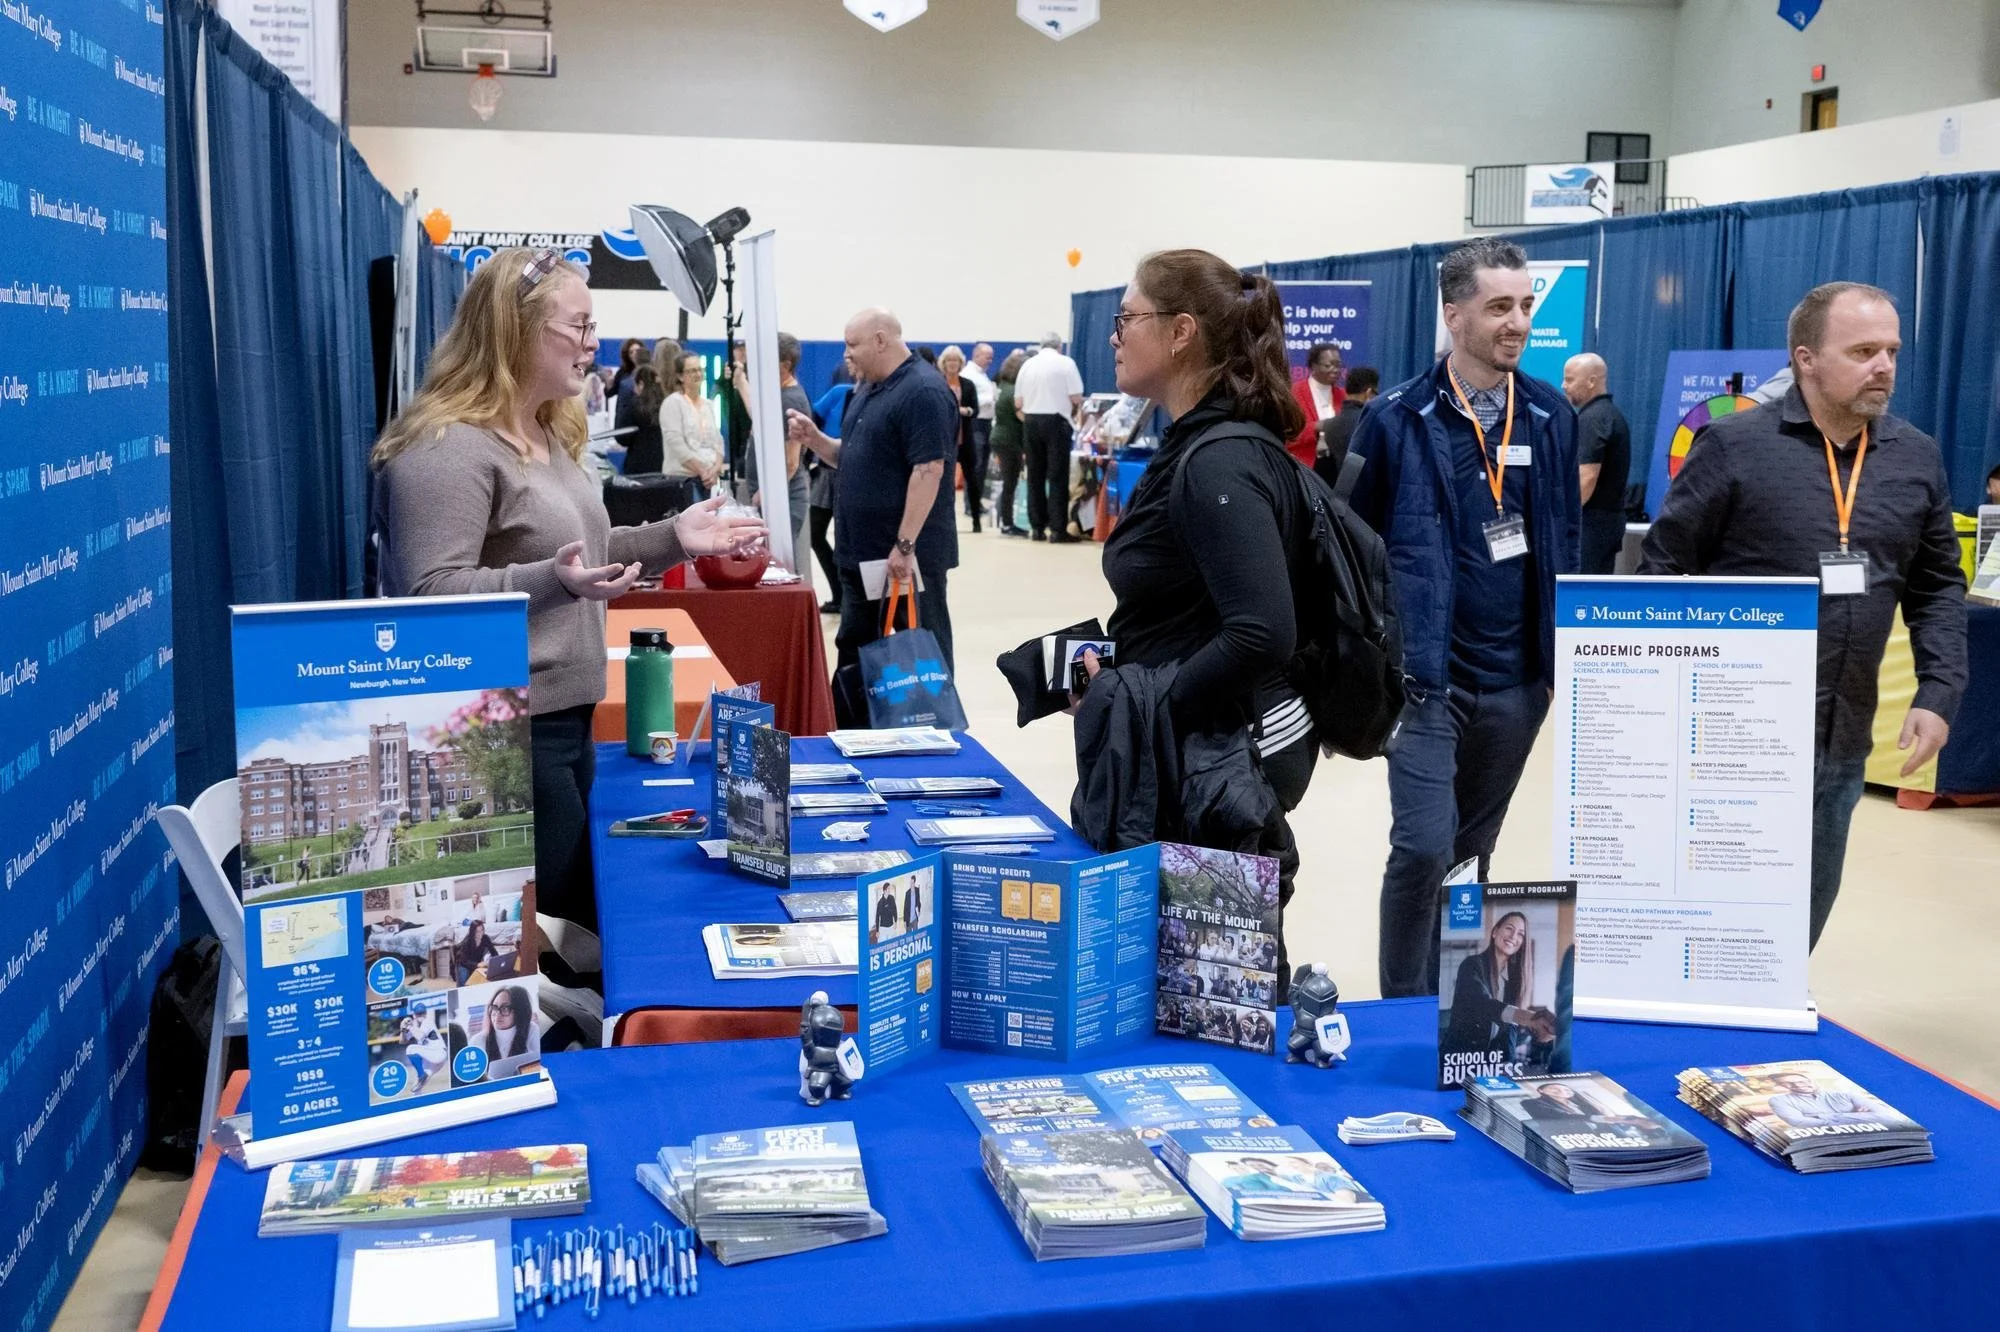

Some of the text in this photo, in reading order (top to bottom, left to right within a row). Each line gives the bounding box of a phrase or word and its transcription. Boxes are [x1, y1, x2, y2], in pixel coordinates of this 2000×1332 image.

[3, 1, 62, 52] Saint Mary College
[37, 192, 106, 236] Mount Saint Mary College
[446, 232, 594, 248] AINT MARY COLLEGE
[78, 285, 114, 309] BE A KNIGHT
[1296, 306, 1356, 318] is here to
[1284, 322, 1334, 336] lp your
[1531, 328, 1560, 337] WATER
[1530, 340, 1568, 348] DAMAGE
[1684, 376, 1758, 388] WE FIX WT'S
[1592, 606, 1784, 625] Mount Saint Mary College
[1574, 644, 1720, 658] ACADEMIC PROGRAMS
[297, 654, 472, 678] Mount Saint Mary College
[350, 676, 426, 690] Newburgh, New York
[869, 672, 948, 696] The Benefit of Blue
[718, 708, 732, 720] ARE
[12, 799, 86, 882] Mount Saint Mary College
[732, 851, 764, 872] TRANSFER
[766, 862, 786, 878] GUIDE
[952, 864, 1031, 878] BRING YOUR CREDITS
[1080, 860, 1128, 878] ACADEMIC PROGRAMS
[1486, 886, 1568, 895] GRADUATE PROGRAMS
[1162, 904, 1262, 932] LIFE AT THE MOUNT
[1456, 914, 1474, 922] College
[952, 922, 1048, 940] TRANSFER SCHOLARSHIPS
[870, 954, 880, 972] IS
[884, 936, 932, 968] PERSONAL
[380, 962, 393, 973] 10
[314, 996, 344, 1010] $70K
[952, 990, 1007, 1003] HOW TO APPLY
[266, 1003, 298, 1018] $30K
[297, 1036, 322, 1050] 3 4
[1444, 1050, 1504, 1066] SCHOOL OF
[296, 1068, 324, 1082] 1959
[382, 1066, 398, 1077] 20
[1102, 1073, 1137, 1085] THE
[1143, 1068, 1210, 1080] MOUNT
[1443, 1062, 1523, 1085] BUSINESS
[968, 1079, 1064, 1094] ARE SAYING
[304, 1096, 339, 1112] ACRES
[765, 1126, 828, 1140] FIRST
[1550, 1132, 1617, 1143] SCHOOL OF
[1784, 1122, 1888, 1140] EDUCATION
[1205, 1138, 1291, 1148] NURSING
[1558, 1138, 1650, 1150] BUSINESS
[448, 1192, 506, 1206] THIS
[518, 1188, 578, 1202] FALL
[449, 1188, 486, 1196] VISIT
[495, 1186, 521, 1194] THE
[1045, 1203, 1188, 1219] TRANSFER GUIDE
